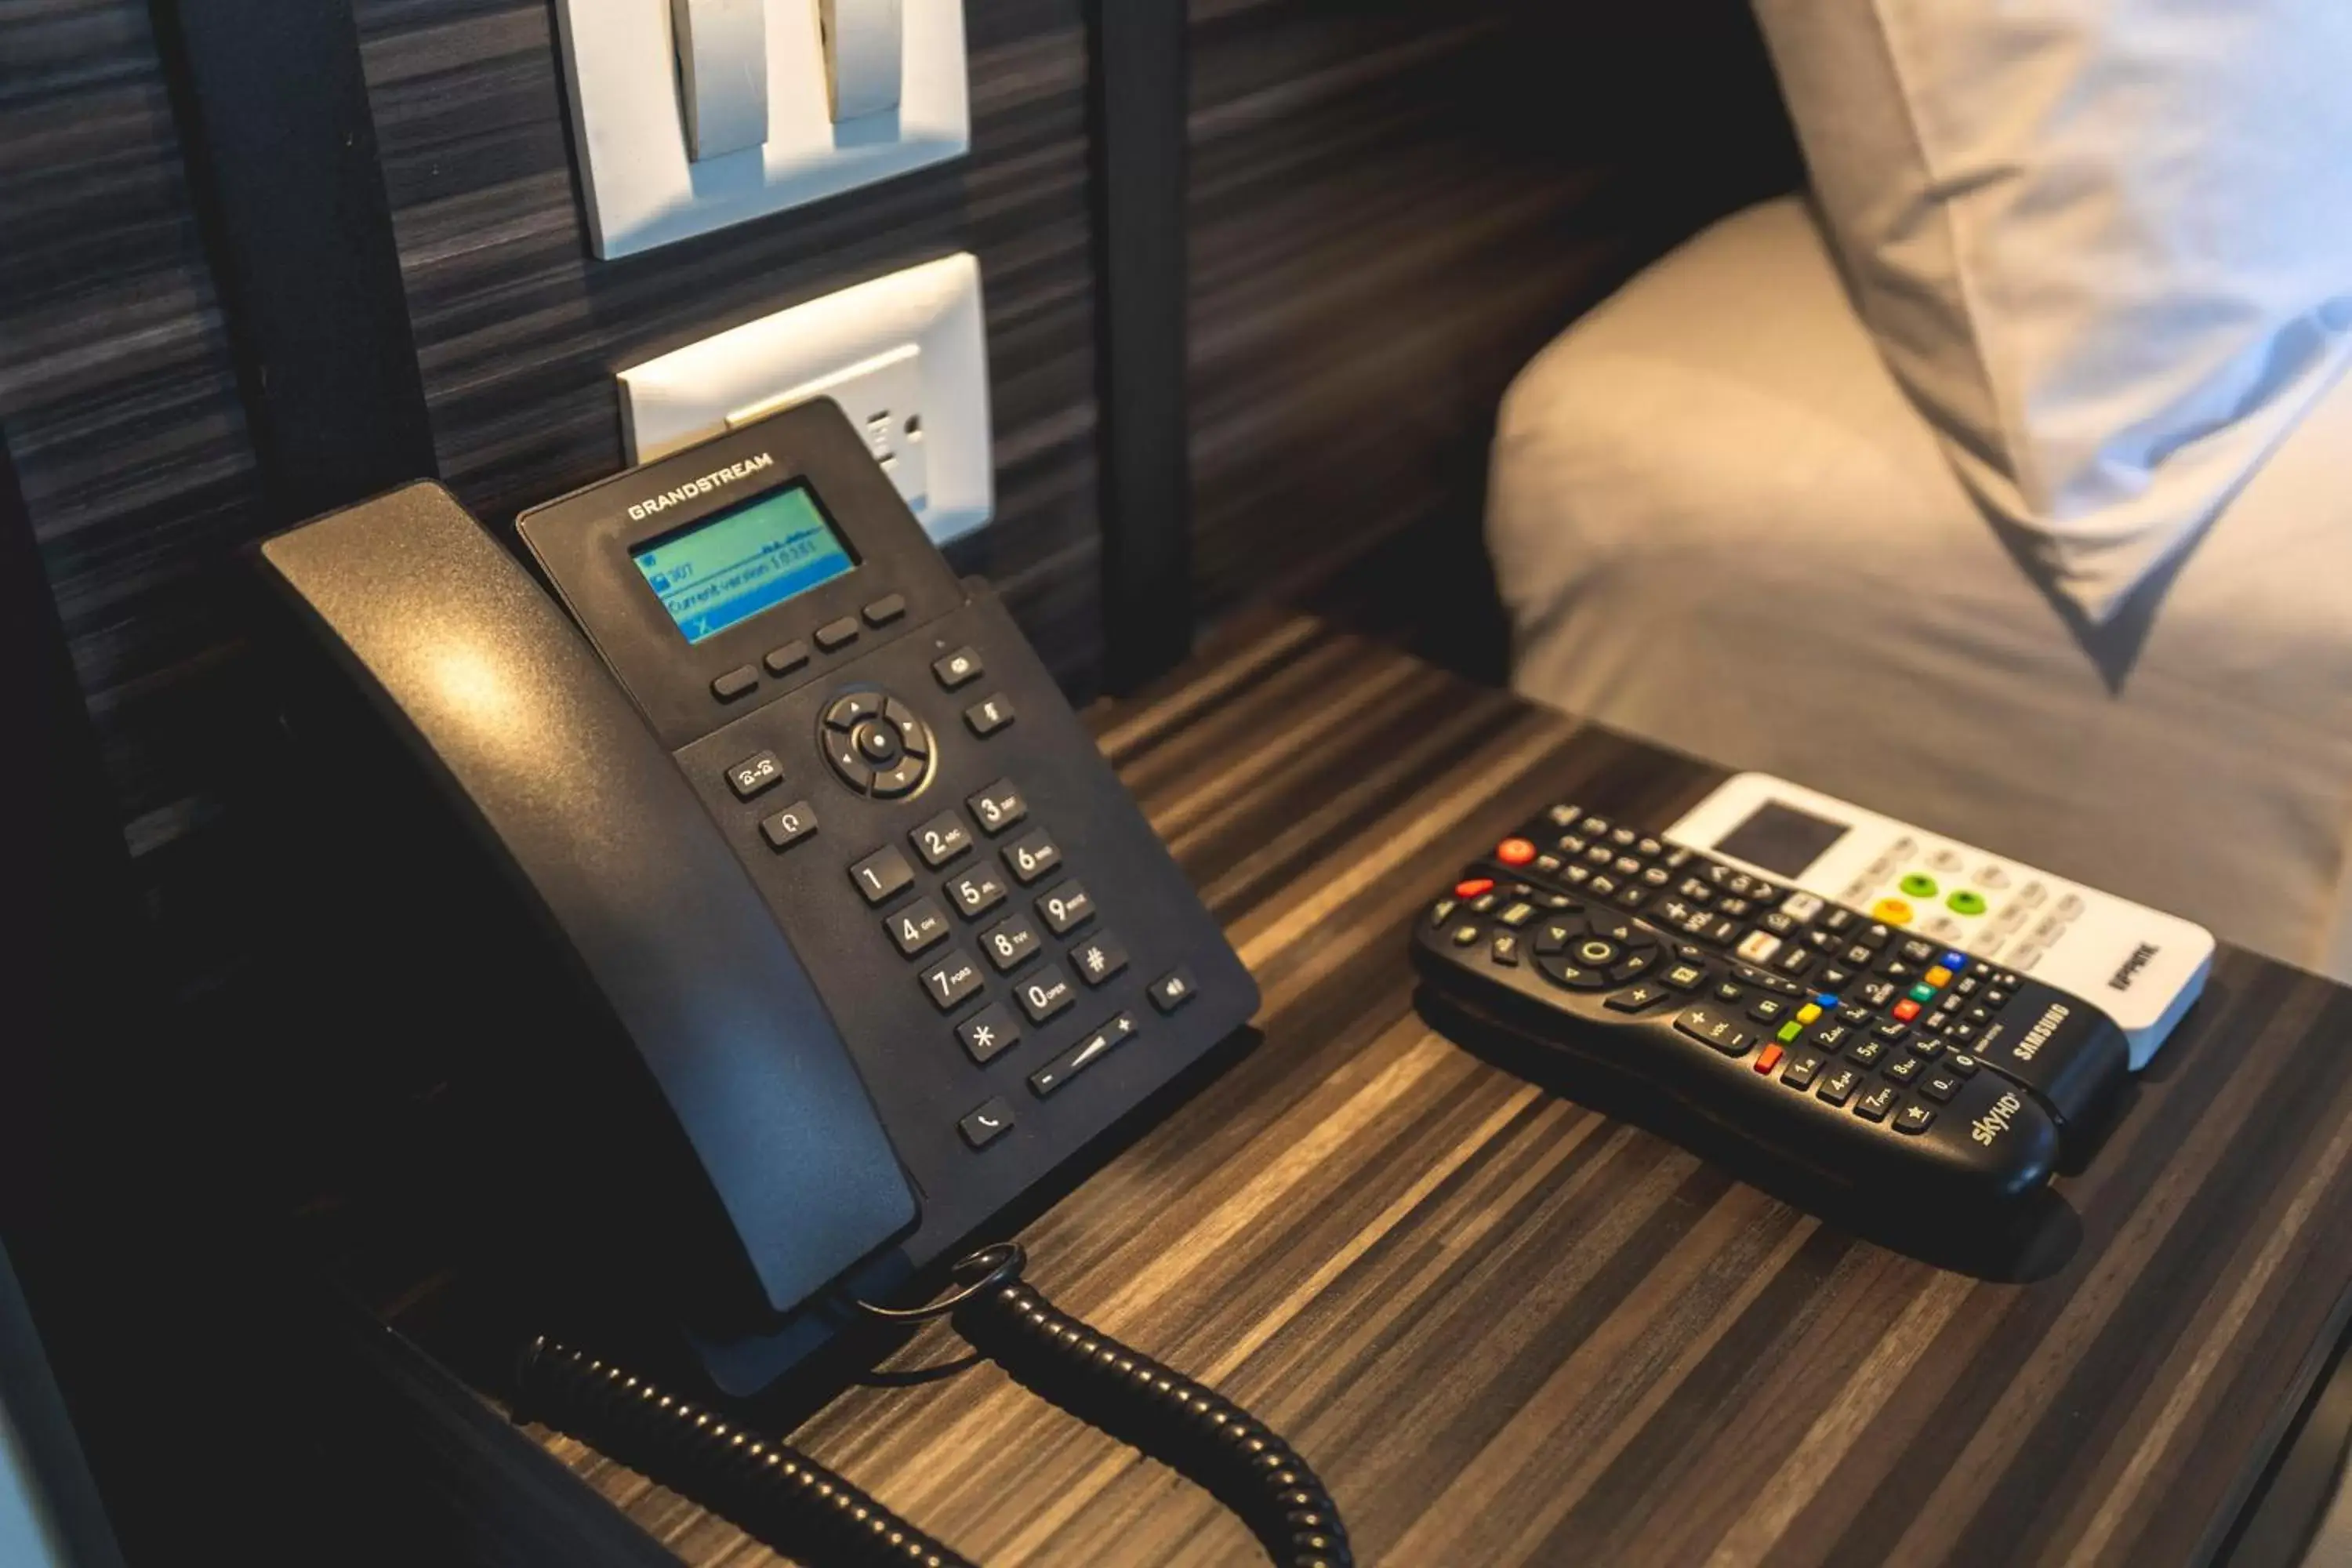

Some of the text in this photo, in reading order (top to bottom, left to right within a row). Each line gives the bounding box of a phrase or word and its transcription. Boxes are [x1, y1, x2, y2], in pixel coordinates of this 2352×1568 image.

[628, 452, 773, 521] GRANDSTREAM
[668, 583, 720, 612] Current
[982, 798, 1000, 821] 3
[924, 831, 946, 855] 2
[1018, 848, 1036, 870] 6
[862, 868, 881, 889] 1
[960, 880, 979, 904] 5
[1048, 898, 1066, 921] 9
[903, 918, 919, 940] 4
[995, 934, 1013, 956] 8
[1087, 946, 1105, 972] #
[932, 971, 949, 996] 7
[1028, 985, 1047, 1007] 0
[2013, 1003, 2070, 1061] SAMSUNG
